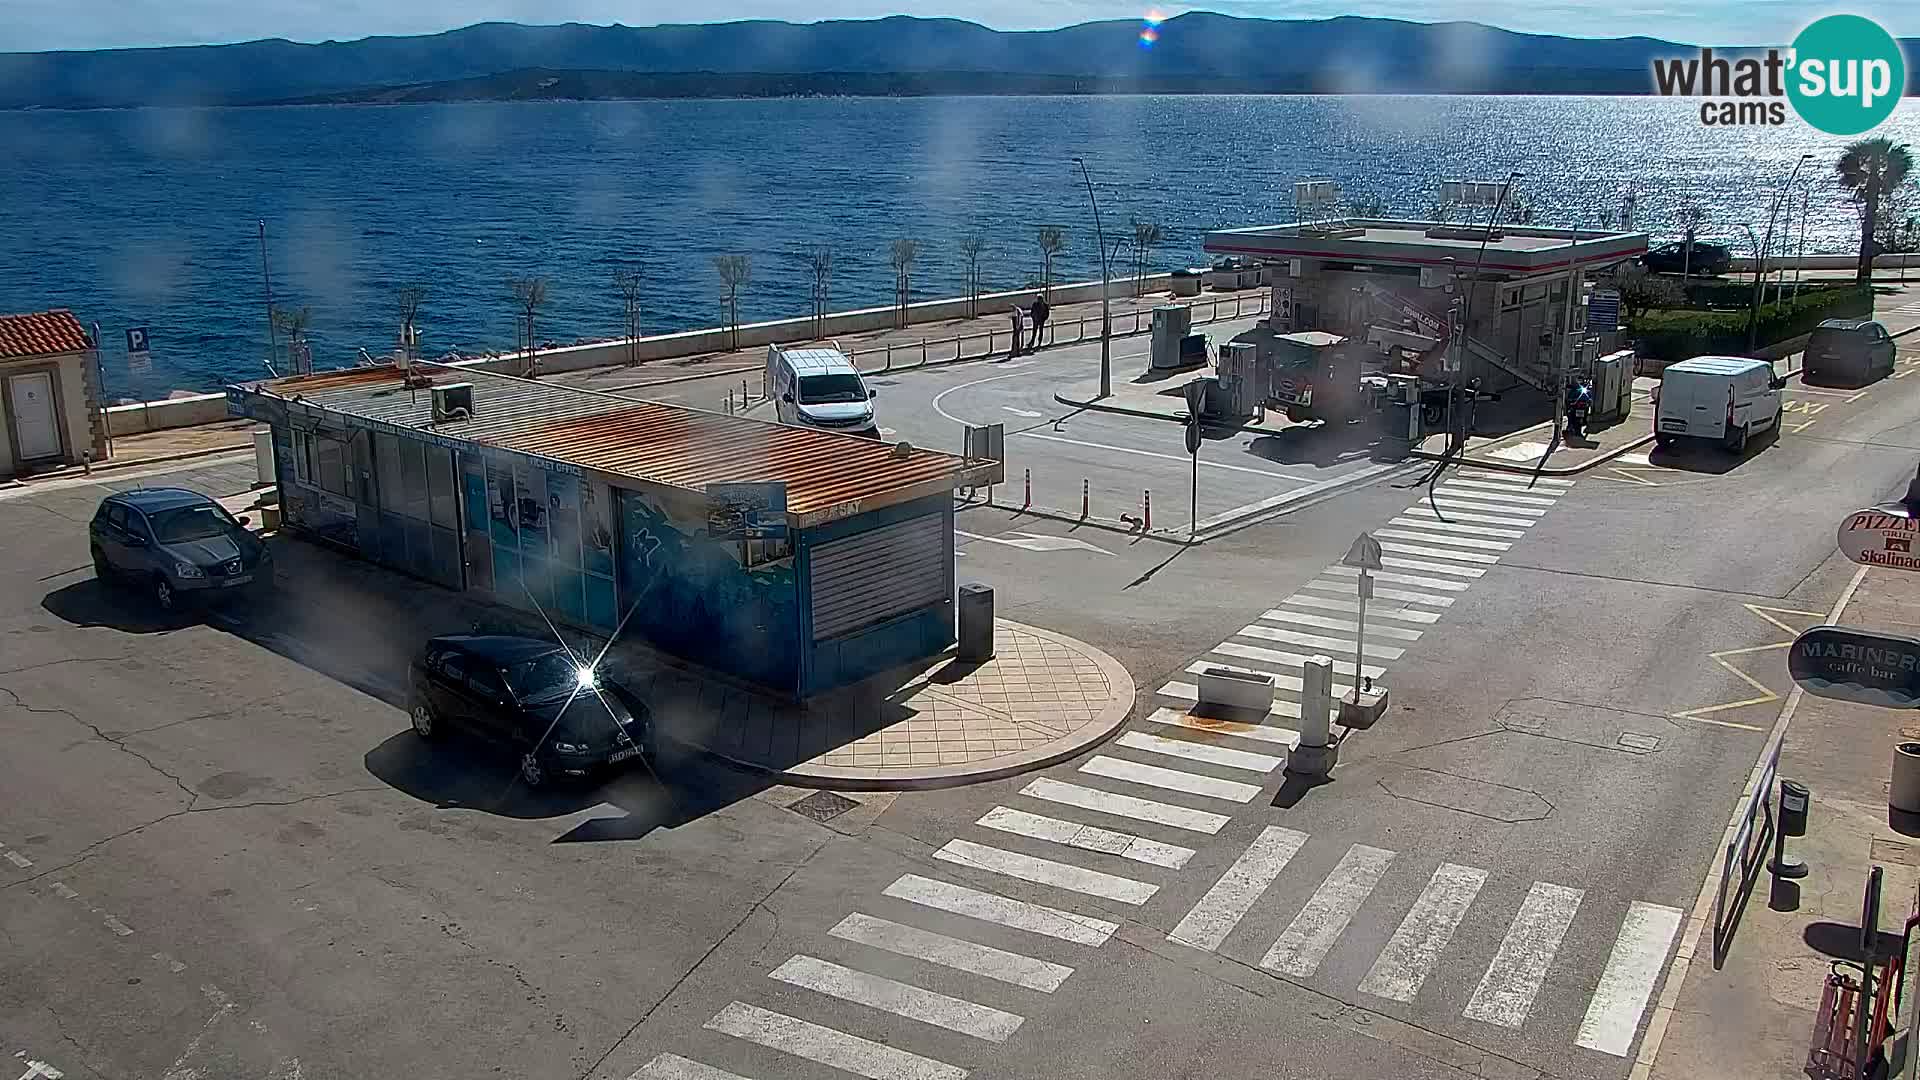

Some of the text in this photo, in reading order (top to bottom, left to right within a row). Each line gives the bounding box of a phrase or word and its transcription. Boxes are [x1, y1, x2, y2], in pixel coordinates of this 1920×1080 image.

[131, 330, 144, 349] P
[1848, 515, 1920, 534] PIZZE
[1870, 666, 1897, 680] bar
